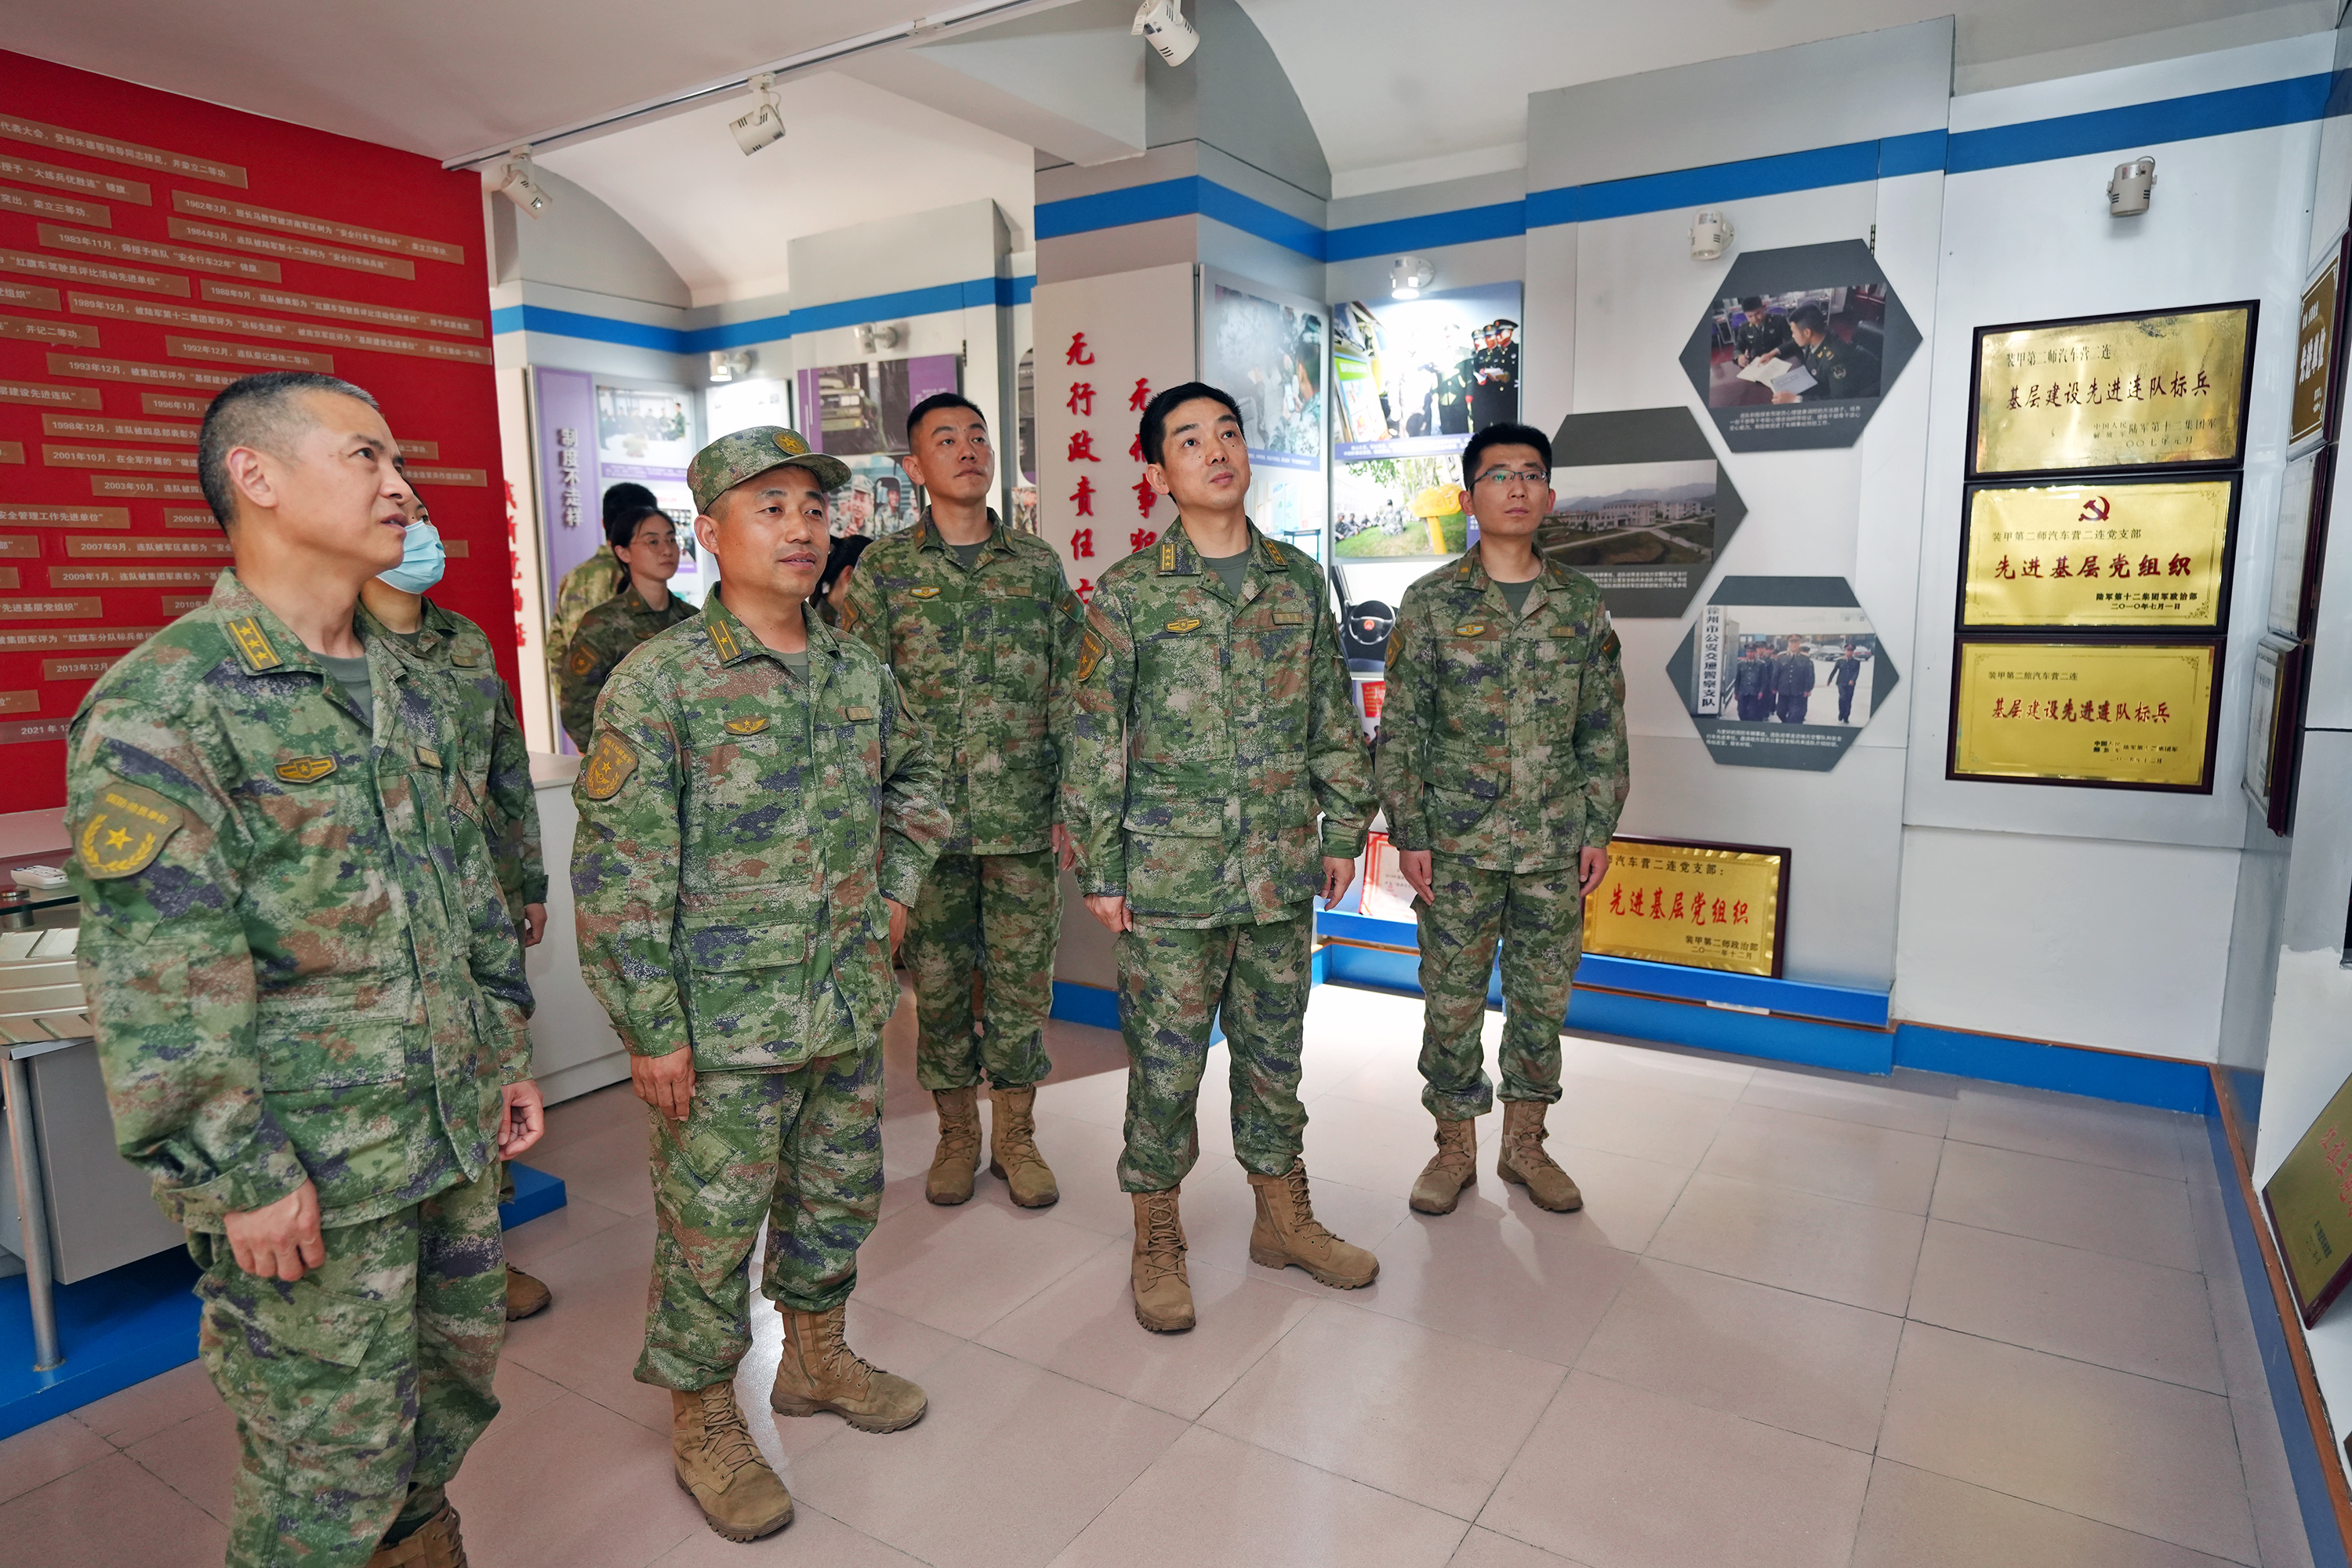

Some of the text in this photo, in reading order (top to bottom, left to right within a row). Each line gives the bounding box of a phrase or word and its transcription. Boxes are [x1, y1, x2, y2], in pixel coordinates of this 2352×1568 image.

[0, 162, 130, 195] 授予“大练兵优胜连”锦旗。
[2006, 343, 2112, 368] 装甲第二师汽车营二连
[2006, 370, 2211, 410] 基层建设先进连队标兵
[2129, 418, 2217, 435] 陆军第十二集团军
[561, 427, 583, 527] 制度不走样
[104, 481, 204, 494] 2003年10月，连队被四
[1992, 528, 2142, 543] 装甲第二师汽车营二连党支部
[1994, 552, 2192, 580] 先进基层党组织
[63, 572, 221, 582] 2009年1月，连队被集团军表彰为“基
[2096, 592, 2198, 601] 陆军第十二集团军政治部
[1988, 671, 2078, 681] 装甲第二旅汽车营二连
[1991, 698, 2170, 724] 基层建设先进连队标兵
[21, 726, 45, 735] 2021
[48, 724, 57, 735] 年
[1610, 883, 1750, 926] 先进基层党组织
[1685, 935, 1759, 952] 装甲第二师政治部
